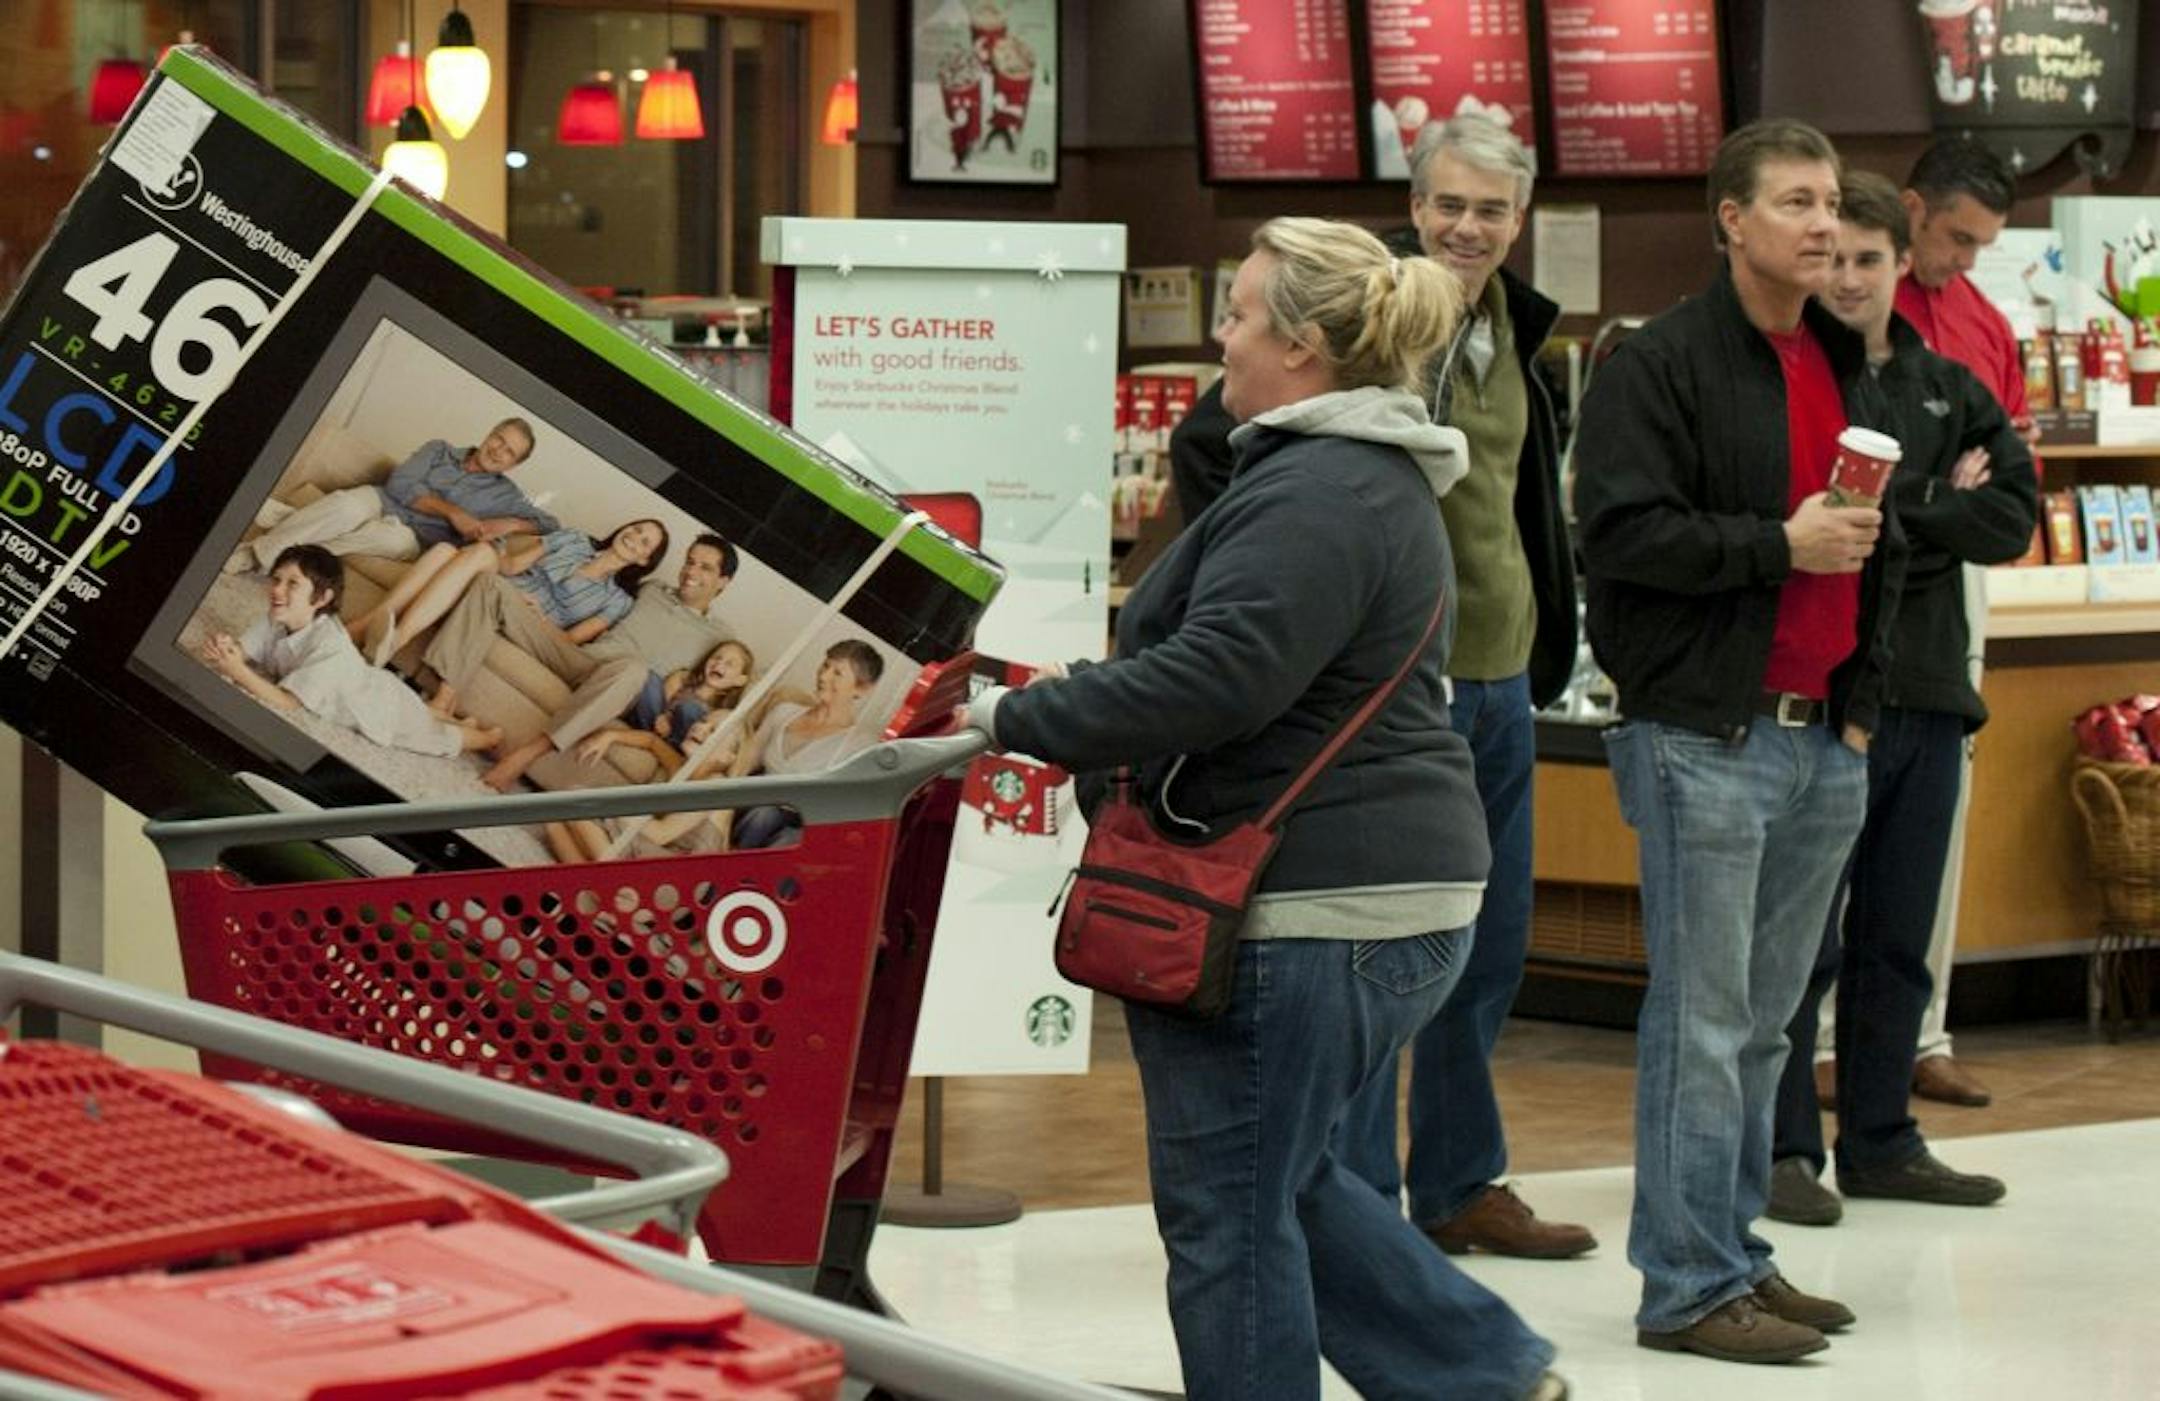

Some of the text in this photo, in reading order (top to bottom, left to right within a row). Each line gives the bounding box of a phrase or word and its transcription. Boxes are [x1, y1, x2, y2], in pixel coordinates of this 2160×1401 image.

[201, 191, 313, 273] Westinghouse
[62, 230, 271, 403] 46
[815, 316, 995, 340] LET'S GATHER
[814, 347, 1024, 374] with good friends.
[853, 380, 913, 393] Starbucks
[0, 352, 177, 507] LCD
[47, 464, 100, 512] FULL
[51, 564, 101, 601] 180P
